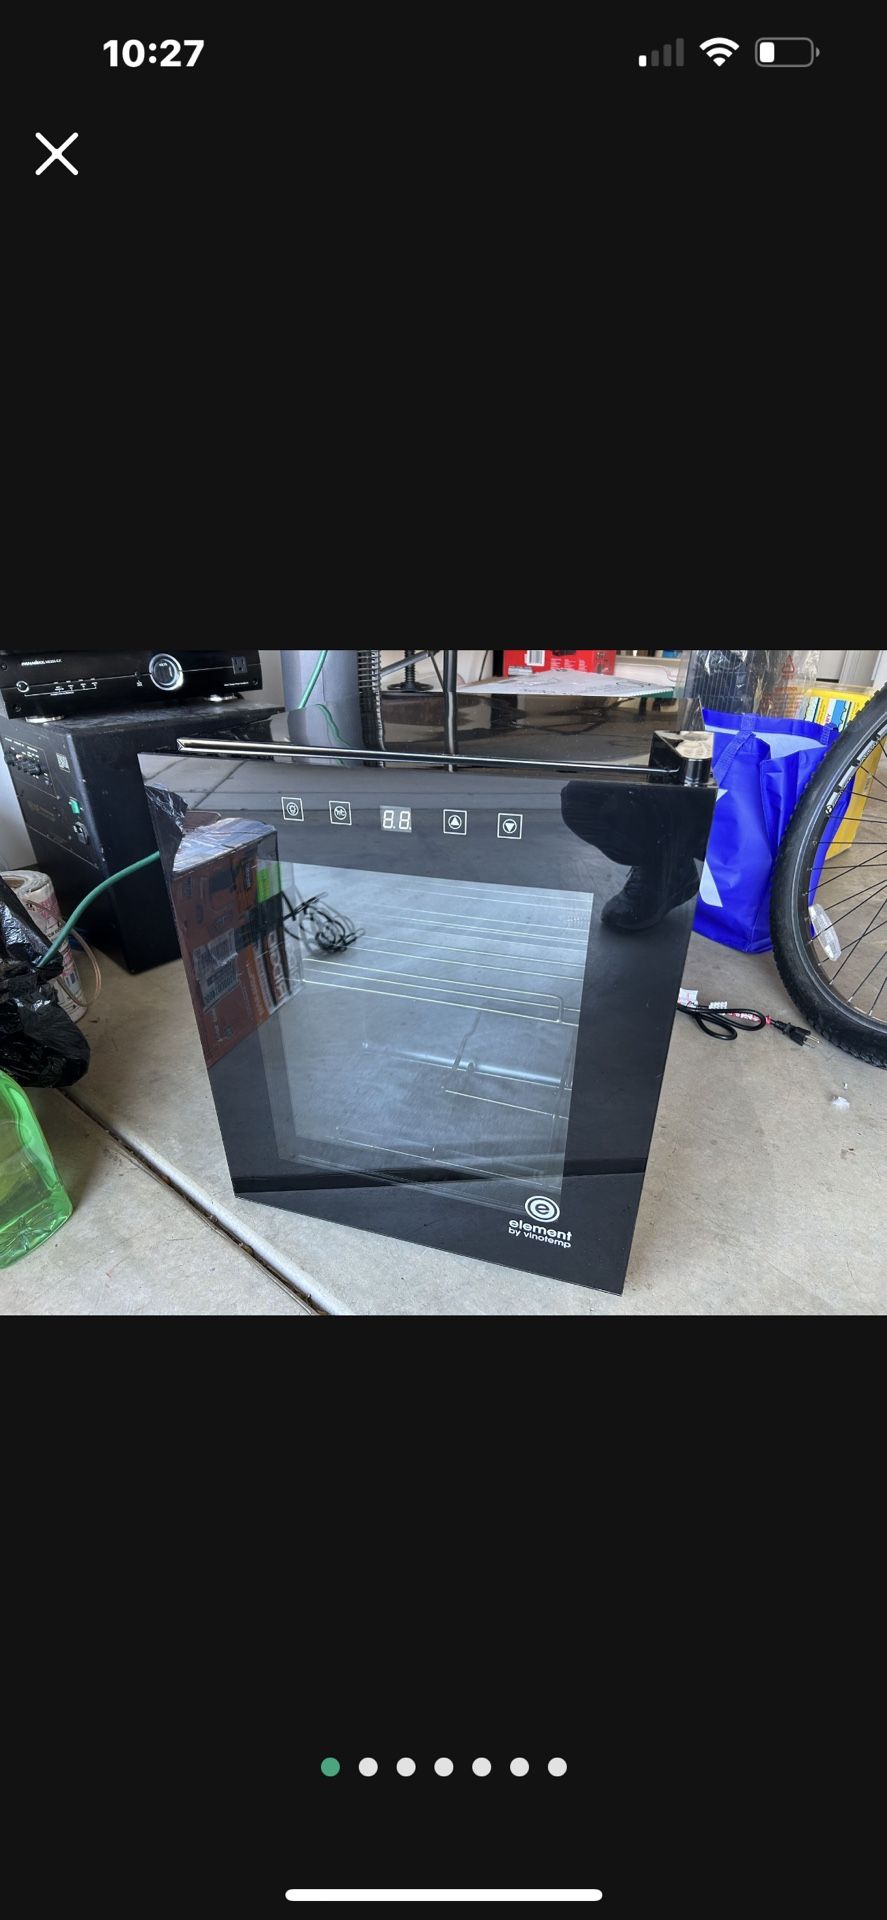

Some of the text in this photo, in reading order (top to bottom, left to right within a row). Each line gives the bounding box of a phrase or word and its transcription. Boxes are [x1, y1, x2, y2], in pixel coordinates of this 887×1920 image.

[508, 1227, 572, 1248] by vinotemp
[509, 1220, 572, 1241] element
